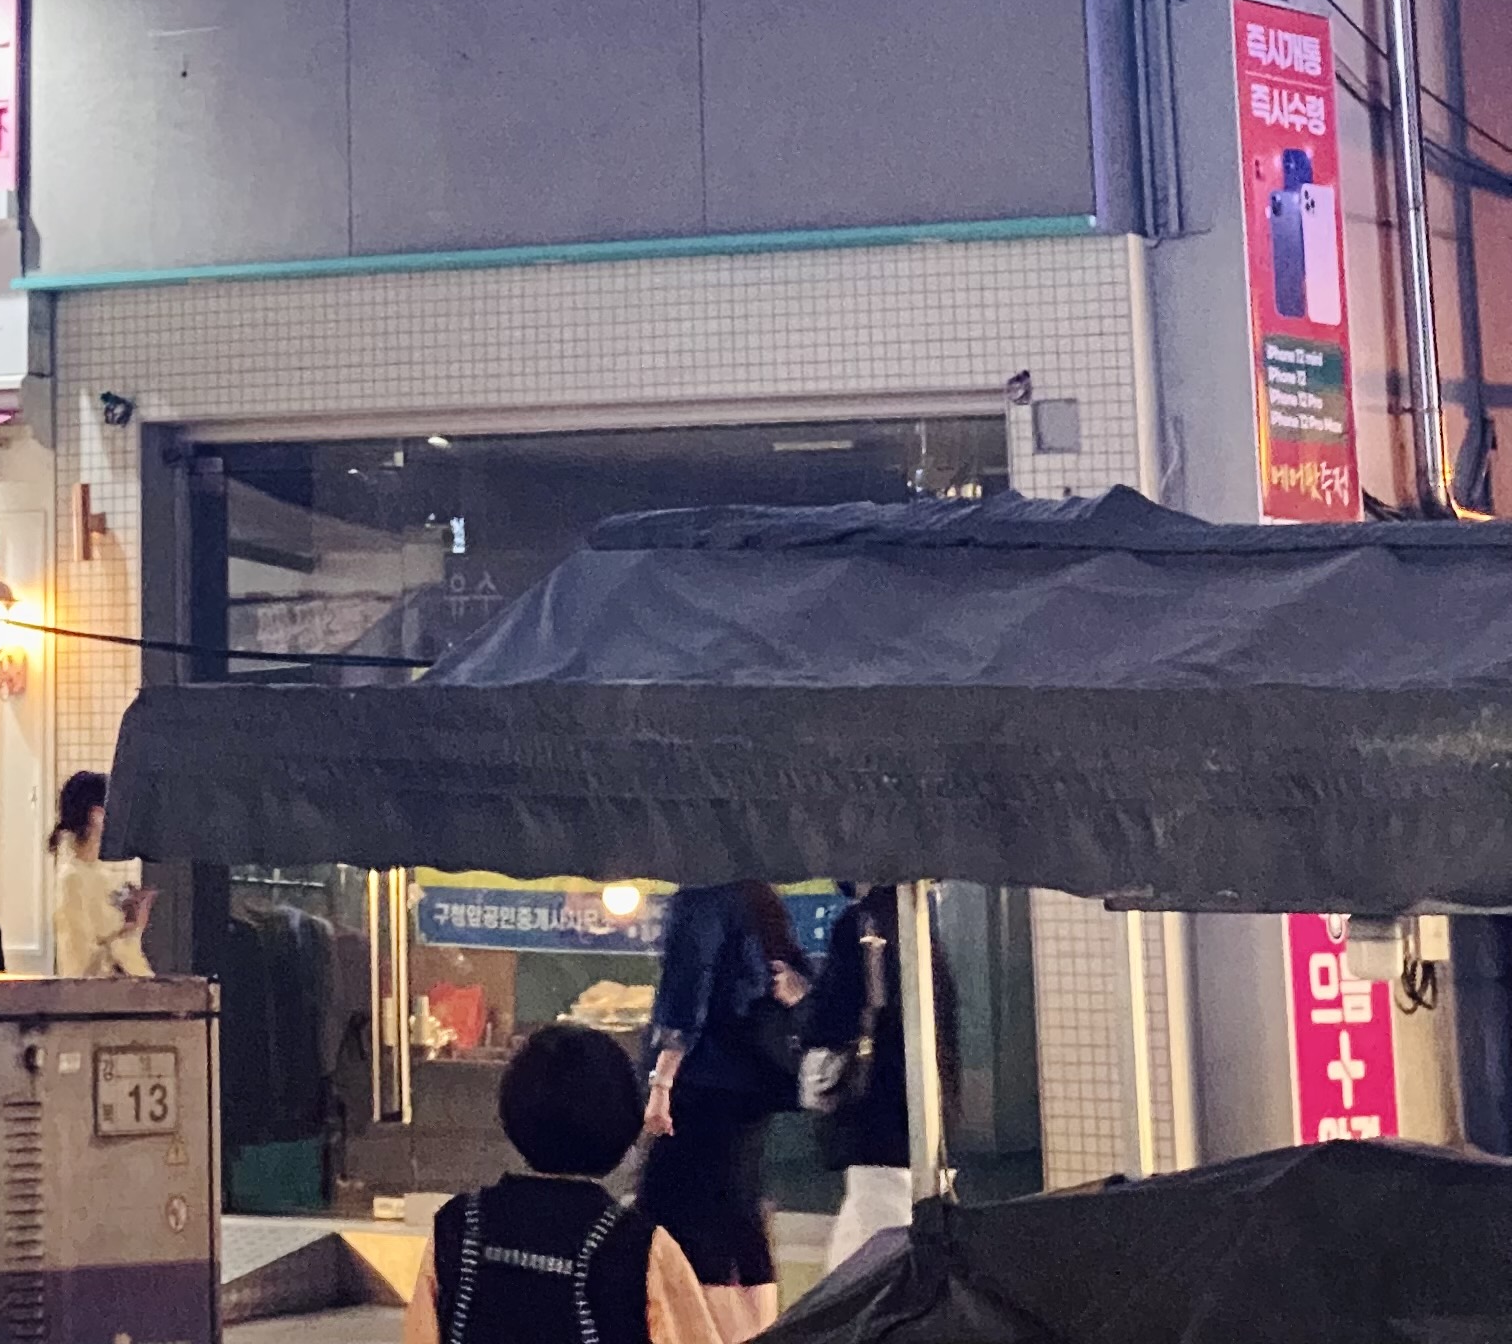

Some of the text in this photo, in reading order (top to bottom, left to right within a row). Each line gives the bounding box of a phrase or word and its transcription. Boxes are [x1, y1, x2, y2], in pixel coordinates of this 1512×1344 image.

[1245, 21, 1322, 77] 즉시개통
[1250, 82, 1326, 136] 즉시수령
[128, 1083, 169, 1123] 13
